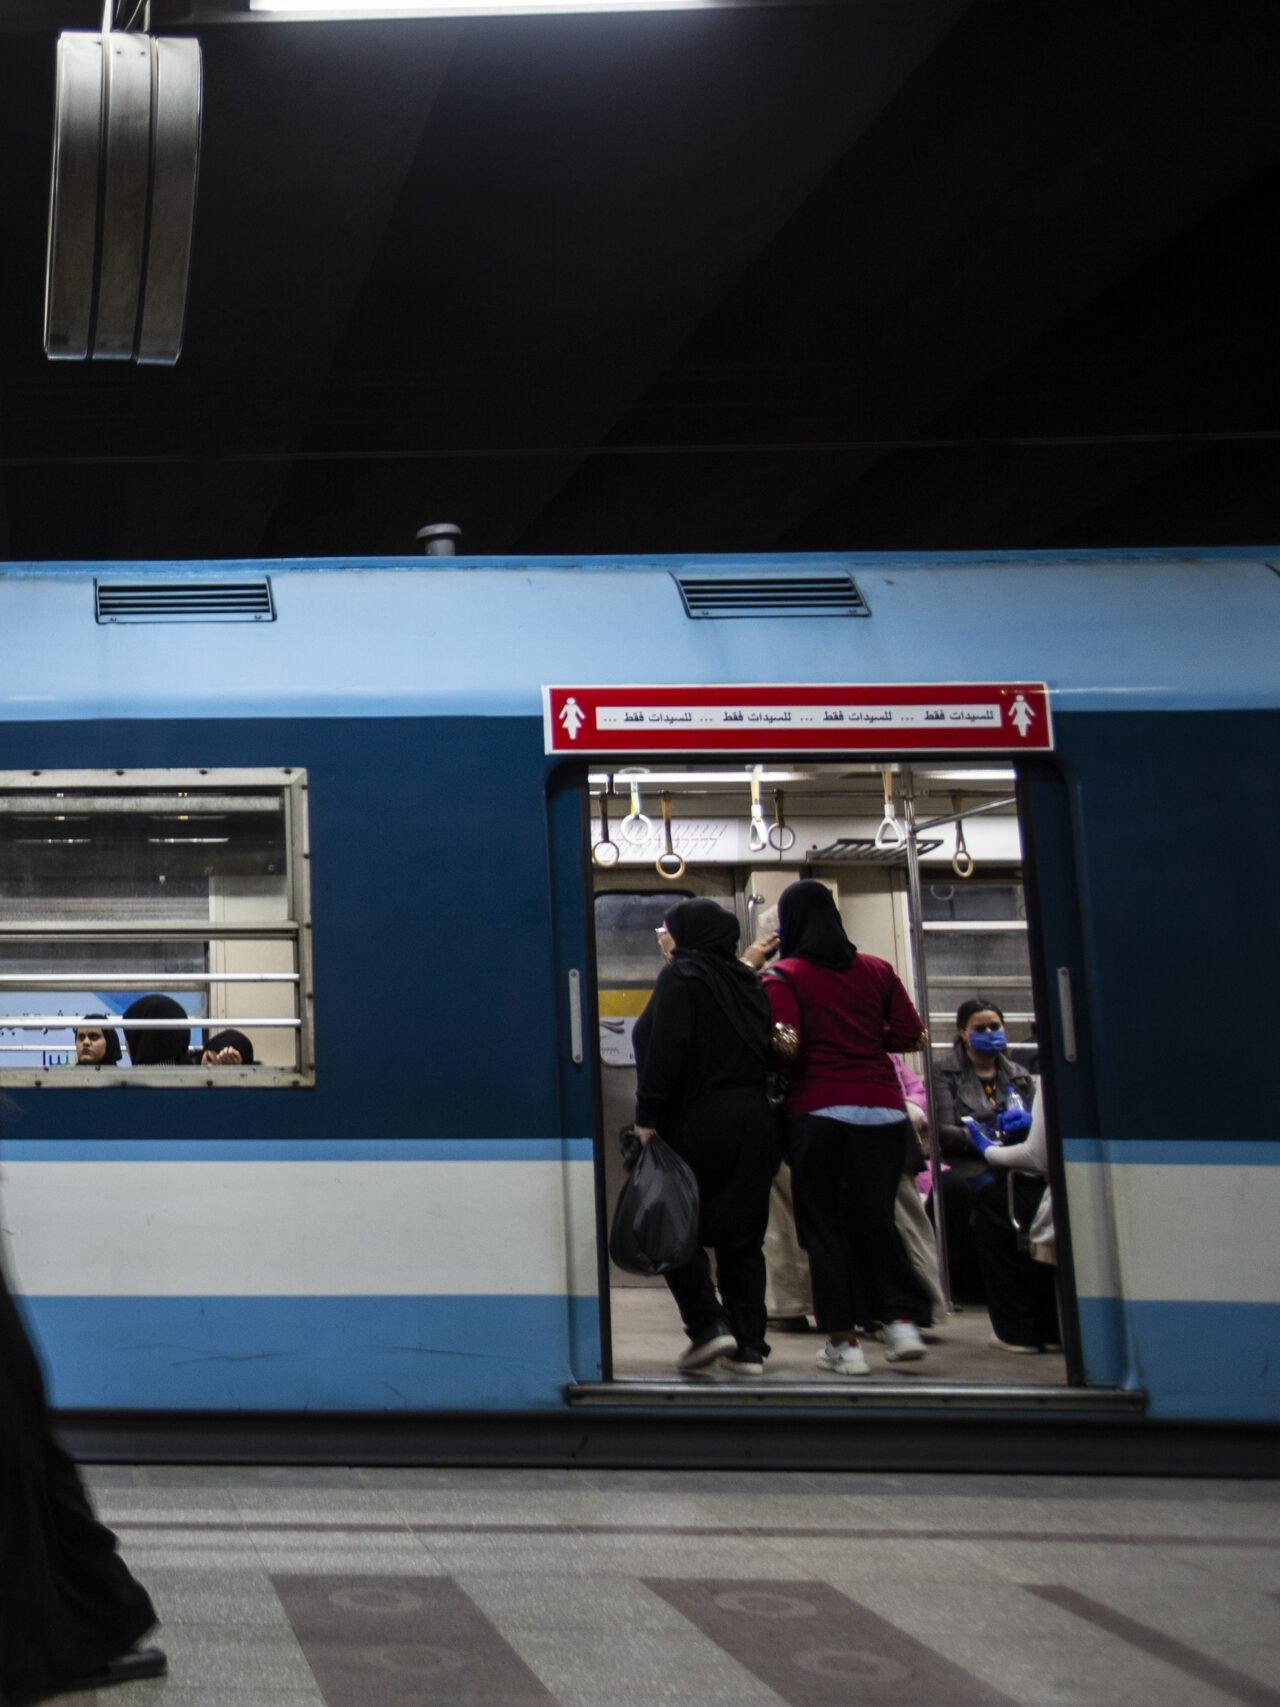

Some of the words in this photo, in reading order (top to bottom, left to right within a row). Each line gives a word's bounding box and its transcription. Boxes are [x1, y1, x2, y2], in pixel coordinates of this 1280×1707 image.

[623, 711, 644, 722] فقط
[648, 713, 692, 725] للسيدات
[723, 711, 744, 722] فقط
[748, 712, 791, 725] للسيدات
[823, 710, 844, 721] فقط
[848, 711, 892, 724] للسيدات
[924, 710, 945, 720] فقط
[949, 711, 994, 723] للسيدات
